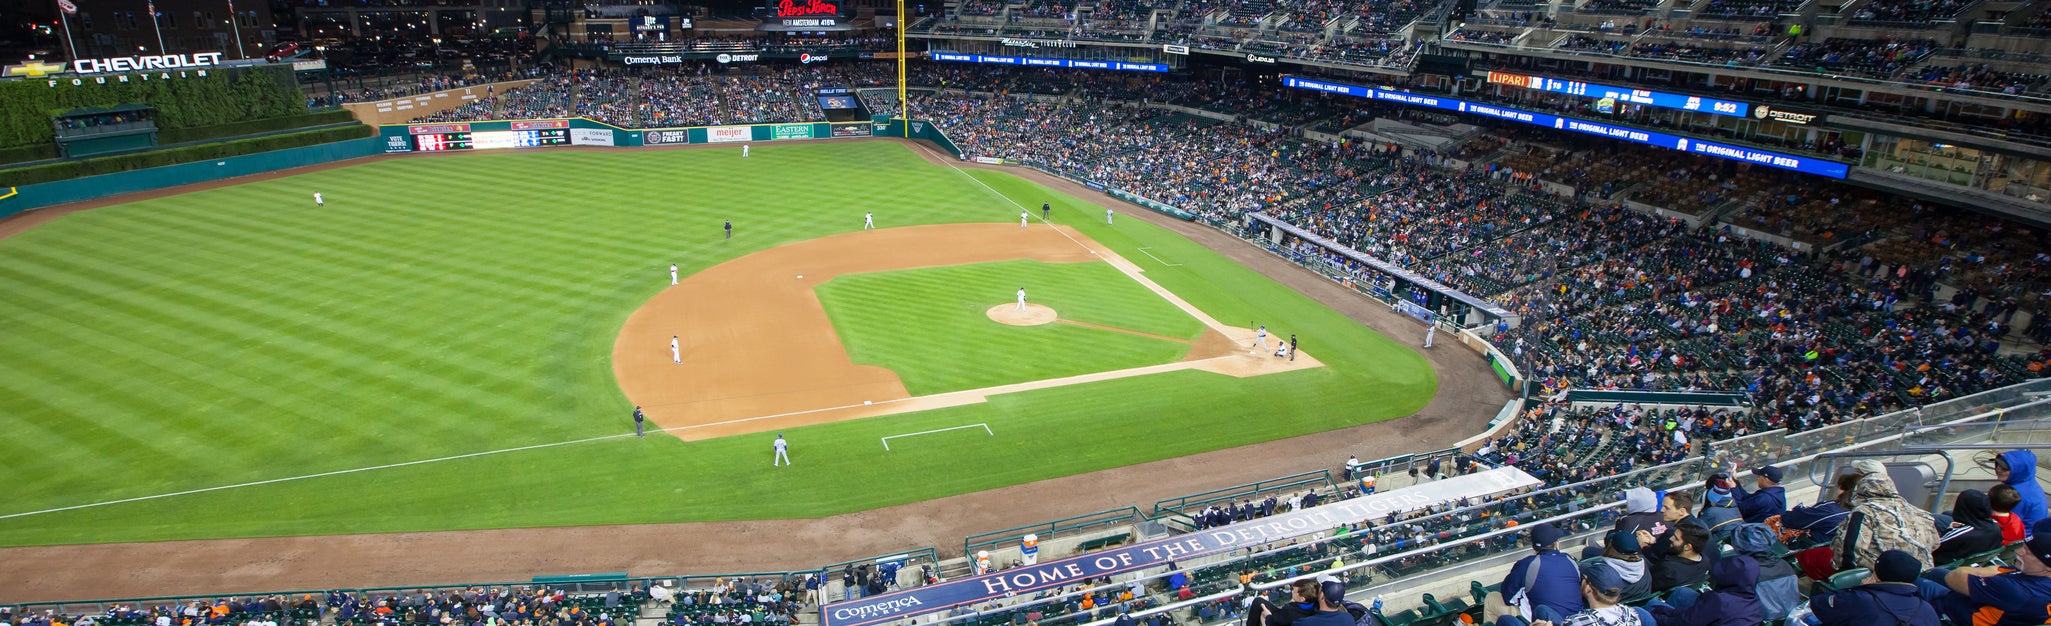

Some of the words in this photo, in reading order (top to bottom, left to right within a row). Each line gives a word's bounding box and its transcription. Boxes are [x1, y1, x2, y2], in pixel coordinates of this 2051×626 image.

[74, 52, 222, 74] CHEVROLET
[661, 55, 682, 63] Bank
[732, 54, 758, 62] DETROIT
[811, 54, 828, 62] pepsi
[48, 69, 207, 88] FOUNTAIN
[1493, 74, 1525, 86] LIPARI
[1304, 81, 1323, 90] ORIGINAL
[1324, 83, 1337, 91] LIGHT
[1384, 93, 1407, 102] ORIGINAL
[1408, 96, 1423, 104] LIGHT
[1423, 98, 1438, 106] BEER
[1714, 102, 1737, 113] 9:52
[1477, 106, 1500, 116] ORIGINAL
[1501, 110, 1517, 119] LIGHT
[1518, 113, 1533, 122] BEER
[1769, 110, 1816, 122] DETROIT
[716, 128, 743, 139] meijer
[776, 126, 809, 134] EASTERN
[1569, 121, 1578, 129] THE
[1578, 123, 1608, 135] ORIGINAL
[1608, 127, 1630, 138] LIGHT
[1629, 131, 1649, 142] BEER
[1695, 143, 1706, 152] THE
[1706, 143, 1745, 159] ORIGINAL
[1746, 152, 1774, 164] LIGHT
[1773, 157, 1799, 168] BEER
[981, 563, 1084, 594] HOME
[1095, 552, 1138, 570] OF
[1142, 539, 1205, 561] THE
[1211, 509, 1337, 546] DETROIT
[1338, 490, 1431, 518] TIGERS
[861, 607, 901, 619] PARK
